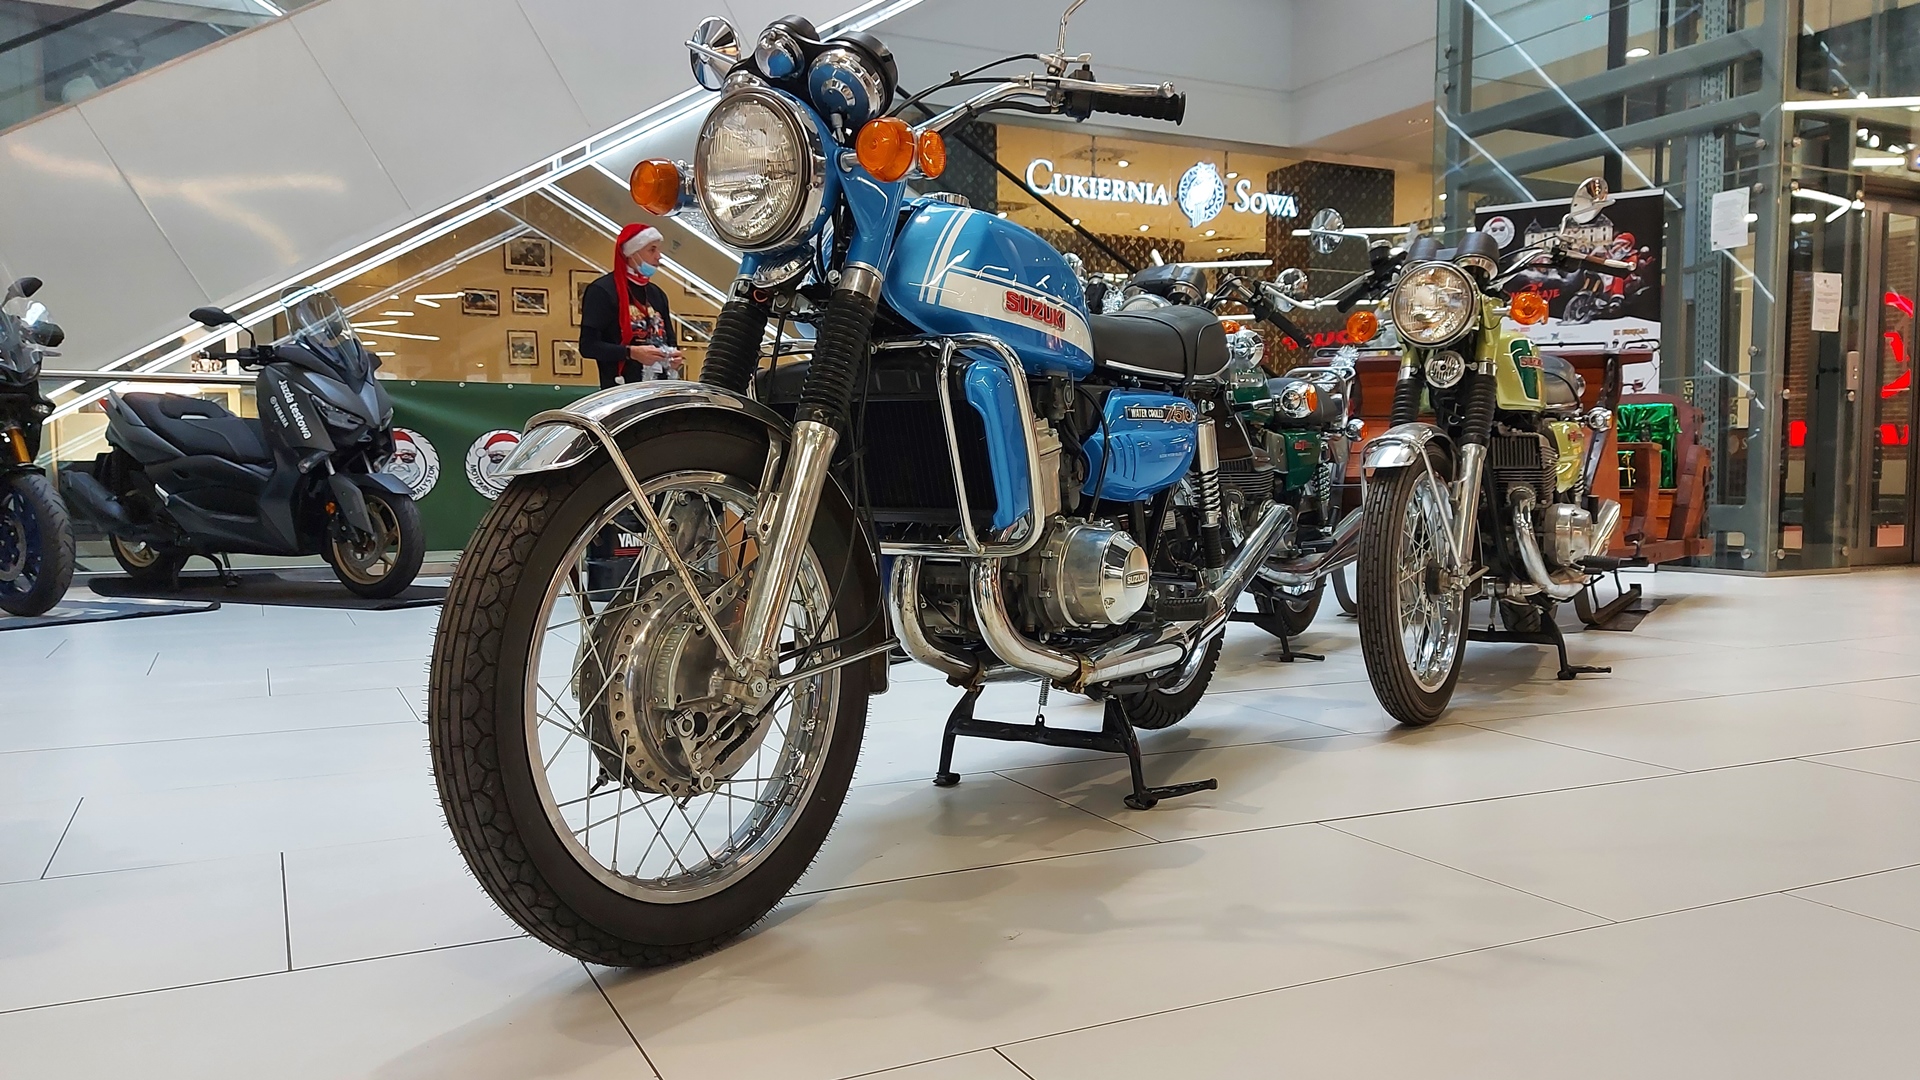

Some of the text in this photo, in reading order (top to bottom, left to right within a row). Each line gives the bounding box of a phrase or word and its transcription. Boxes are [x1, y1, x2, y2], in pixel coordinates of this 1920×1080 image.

[1005, 290, 1066, 331] SUZUKI
[273, 402, 290, 428] YAMAHA
[278, 380, 311, 440] Jazda testowa
[1130, 405, 1193, 424] WATER COOLED 750
[1126, 573, 1147, 585] SUZUKI
